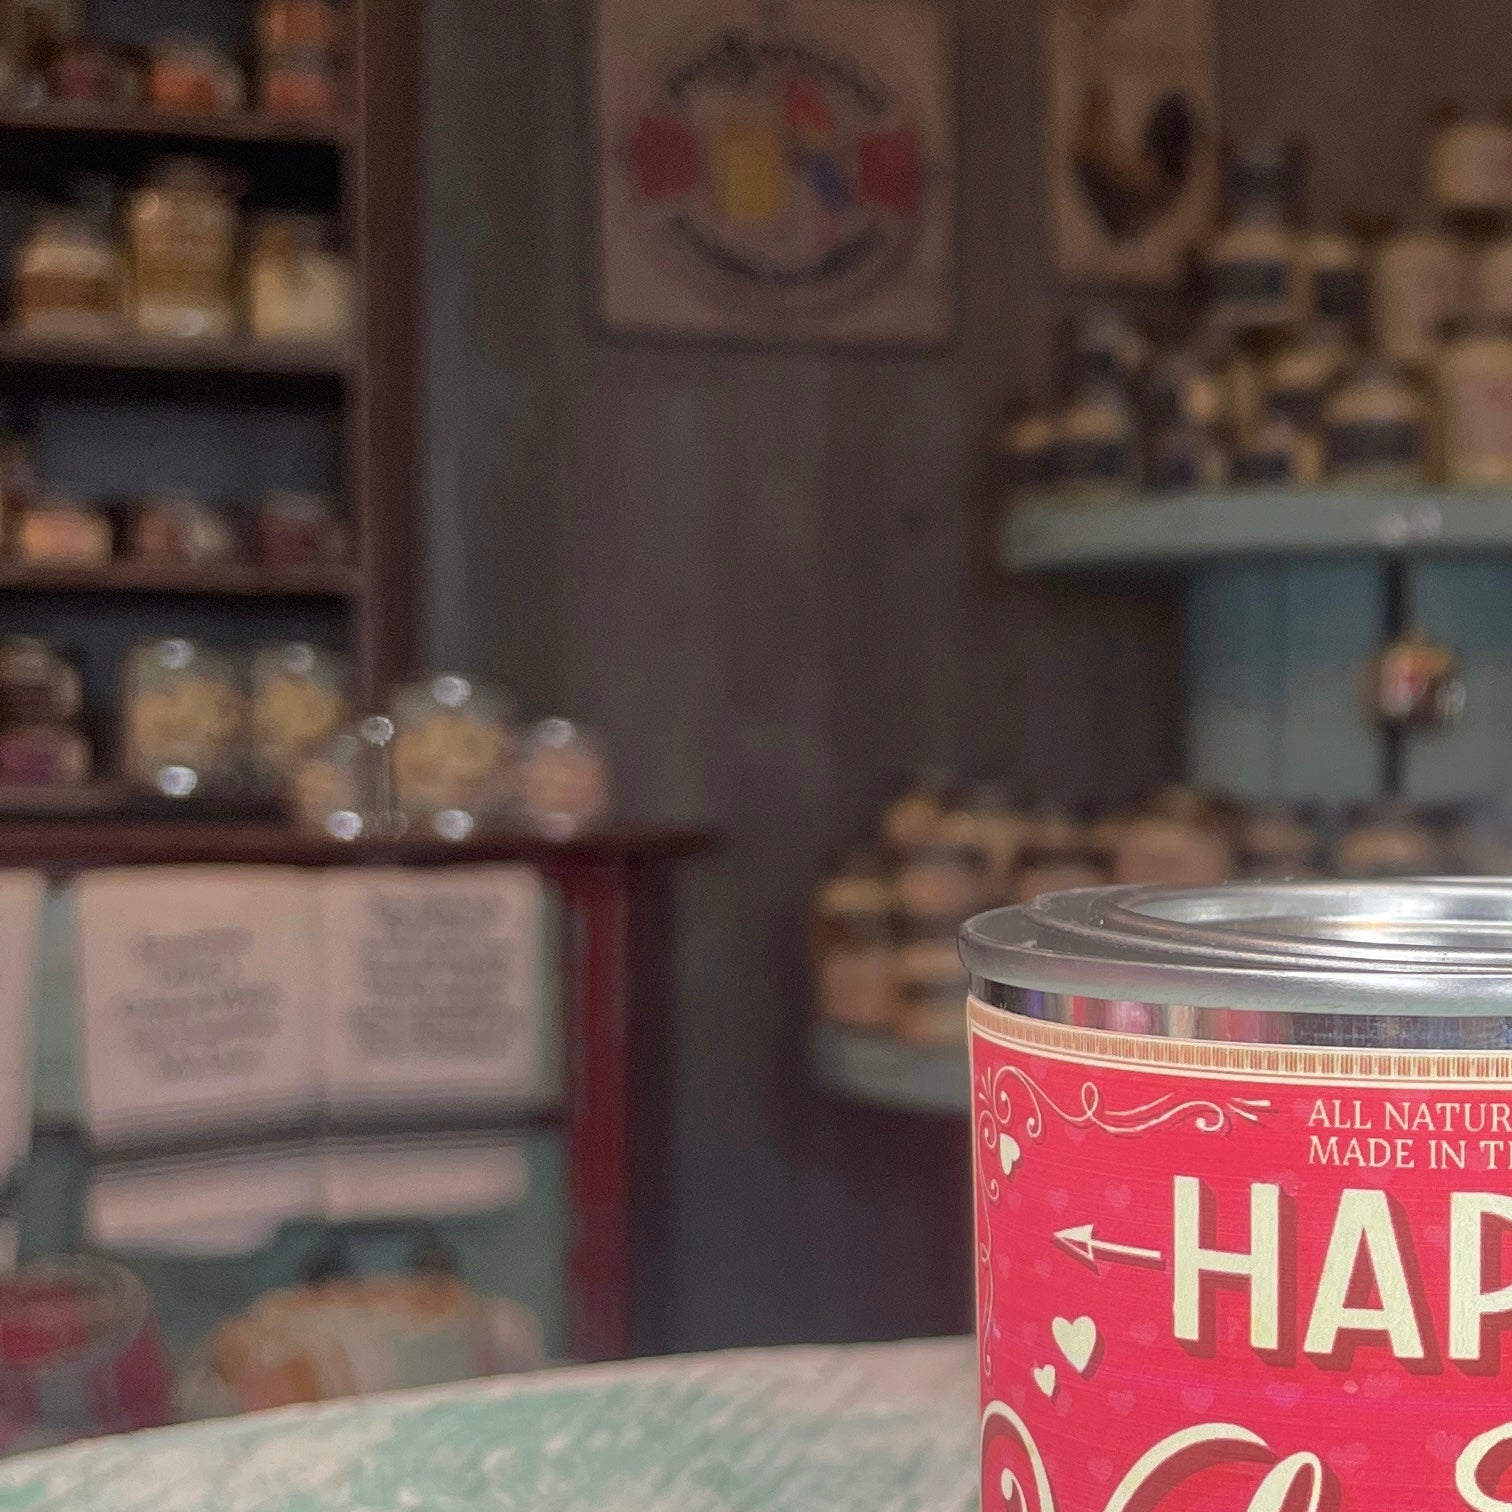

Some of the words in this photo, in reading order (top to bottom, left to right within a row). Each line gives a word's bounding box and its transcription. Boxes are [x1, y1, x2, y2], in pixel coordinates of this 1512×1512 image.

[1308, 1098, 1372, 1130] ALL
[1308, 1135, 1415, 1168] MADE
[1428, 1139, 1466, 1169] IN
